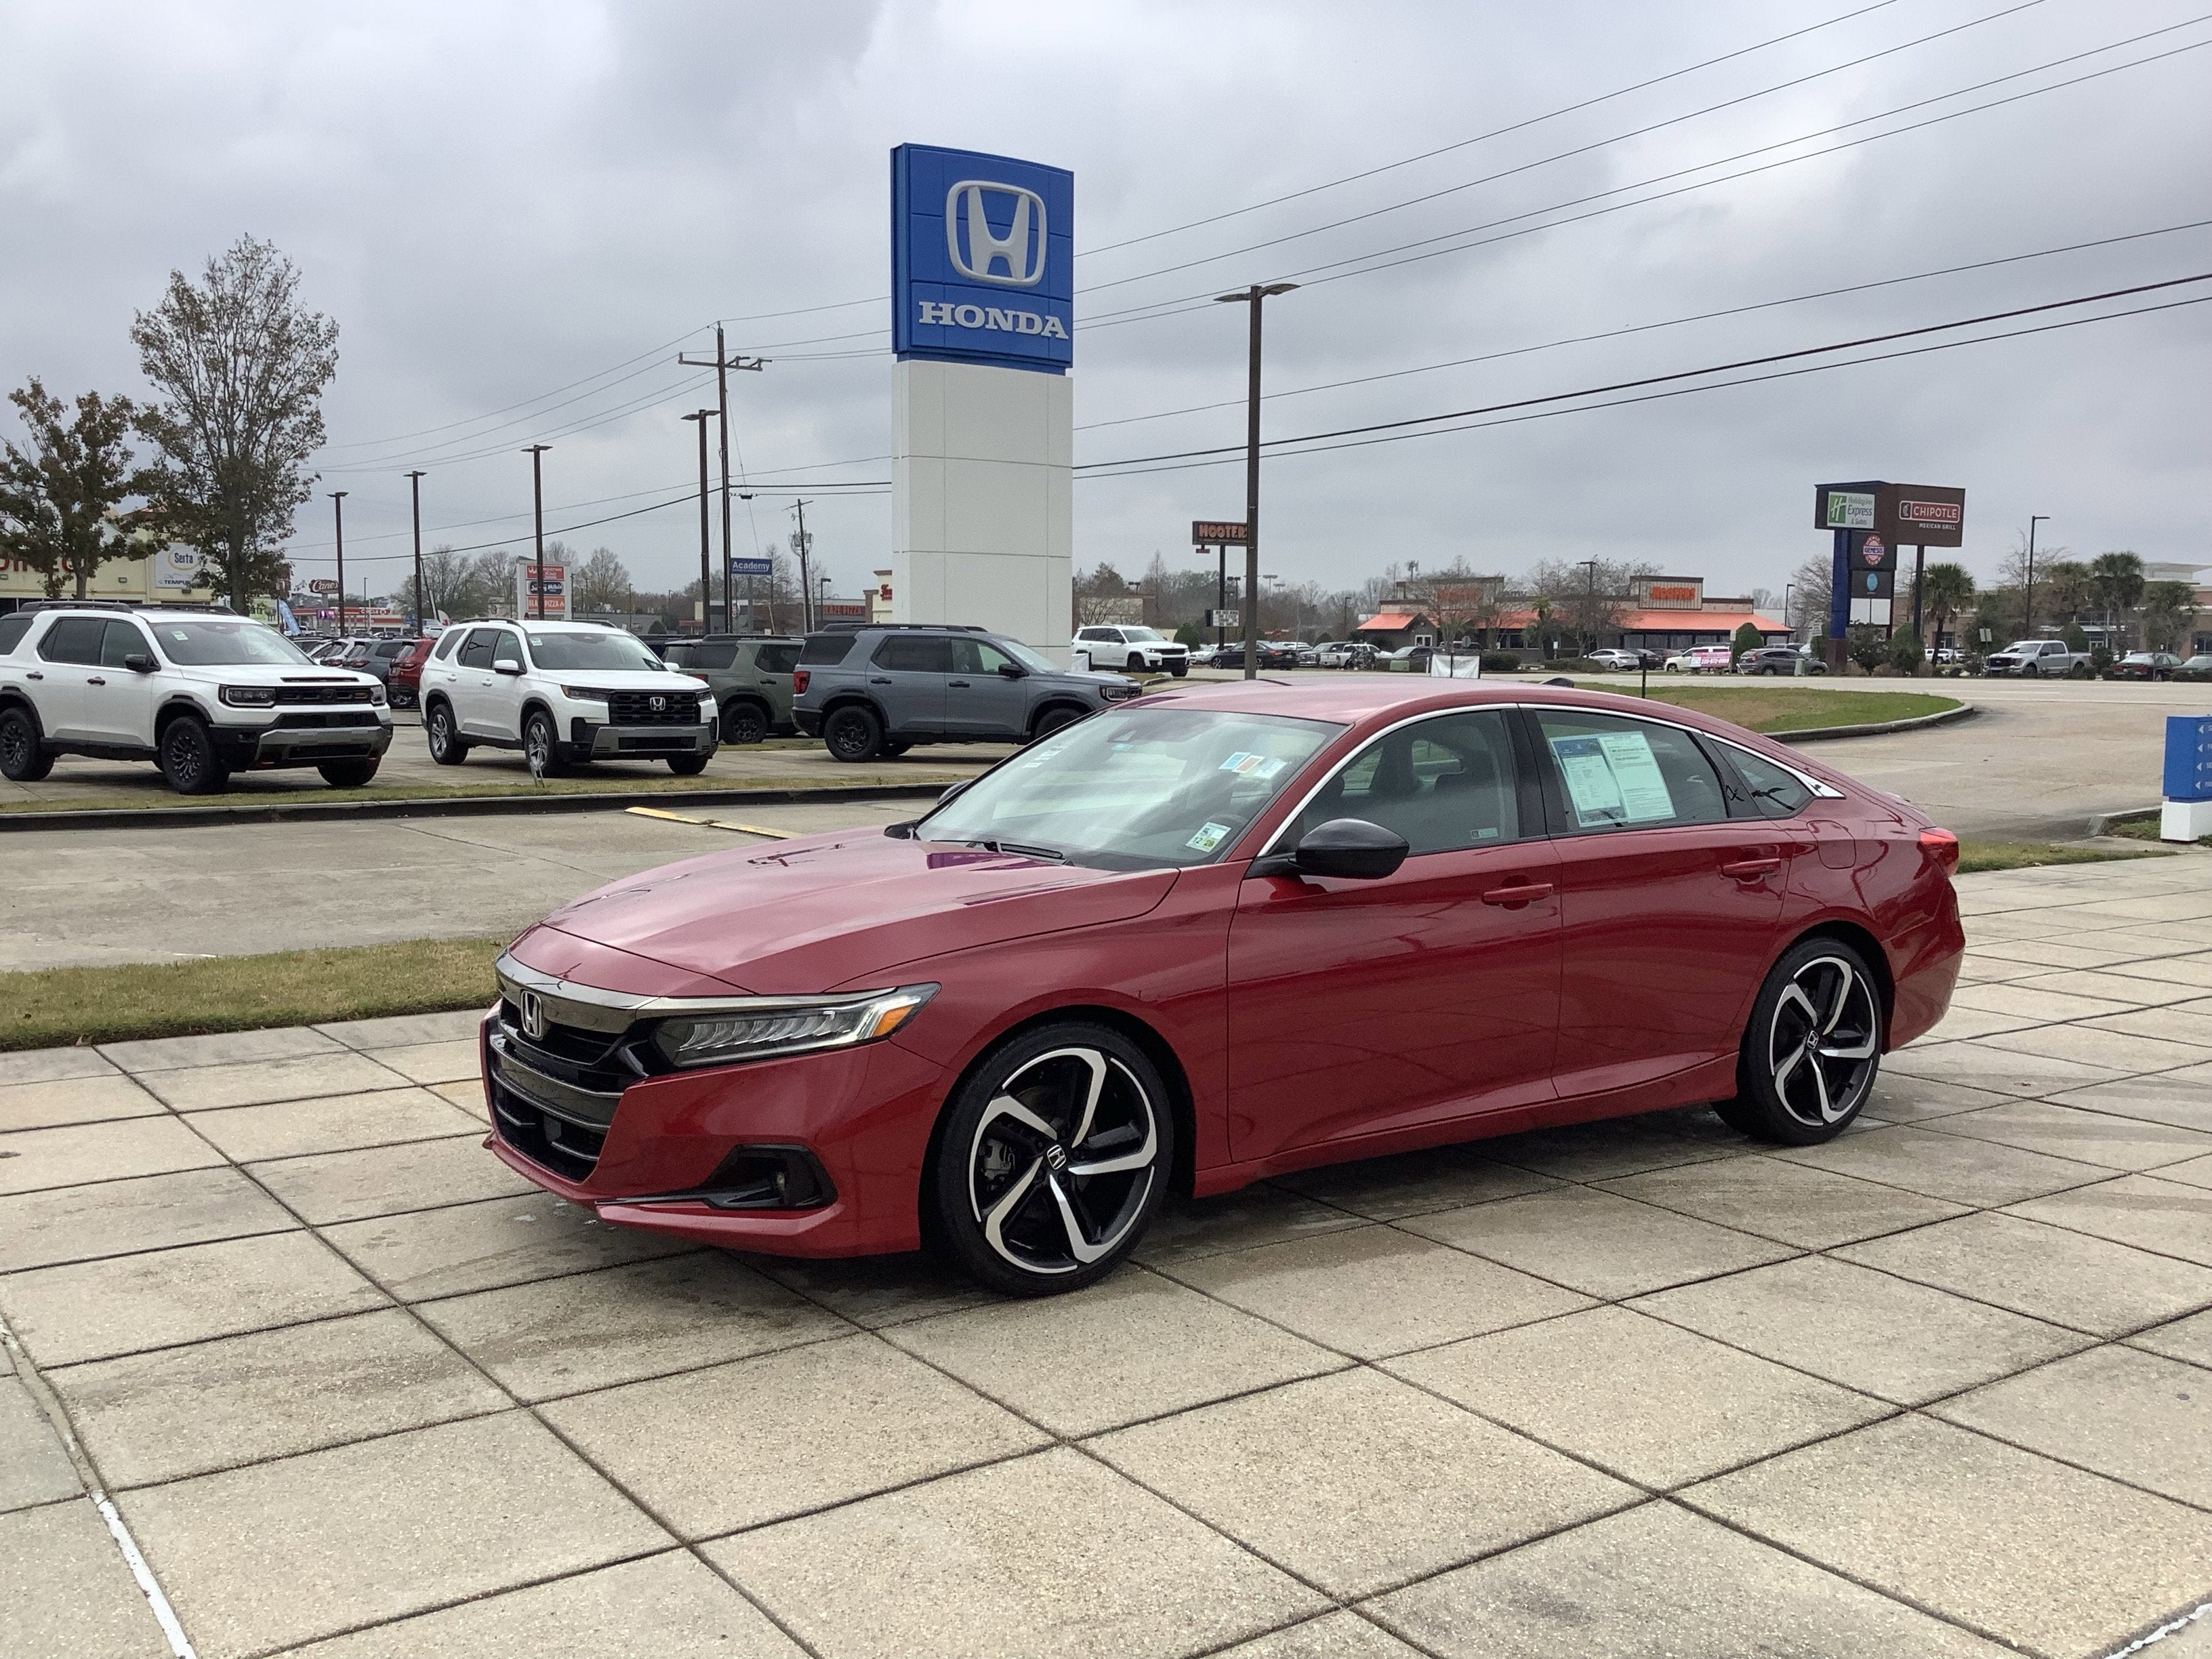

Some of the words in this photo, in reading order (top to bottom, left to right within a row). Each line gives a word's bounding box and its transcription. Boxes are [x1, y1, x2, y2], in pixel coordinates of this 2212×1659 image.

[918, 301, 1069, 340] HONDA
[1847, 504, 1872, 517] Express
[1913, 506, 1957, 518] CHIPOTLE
[174, 552, 193, 564] Serta
[733, 561, 770, 572] Academy
